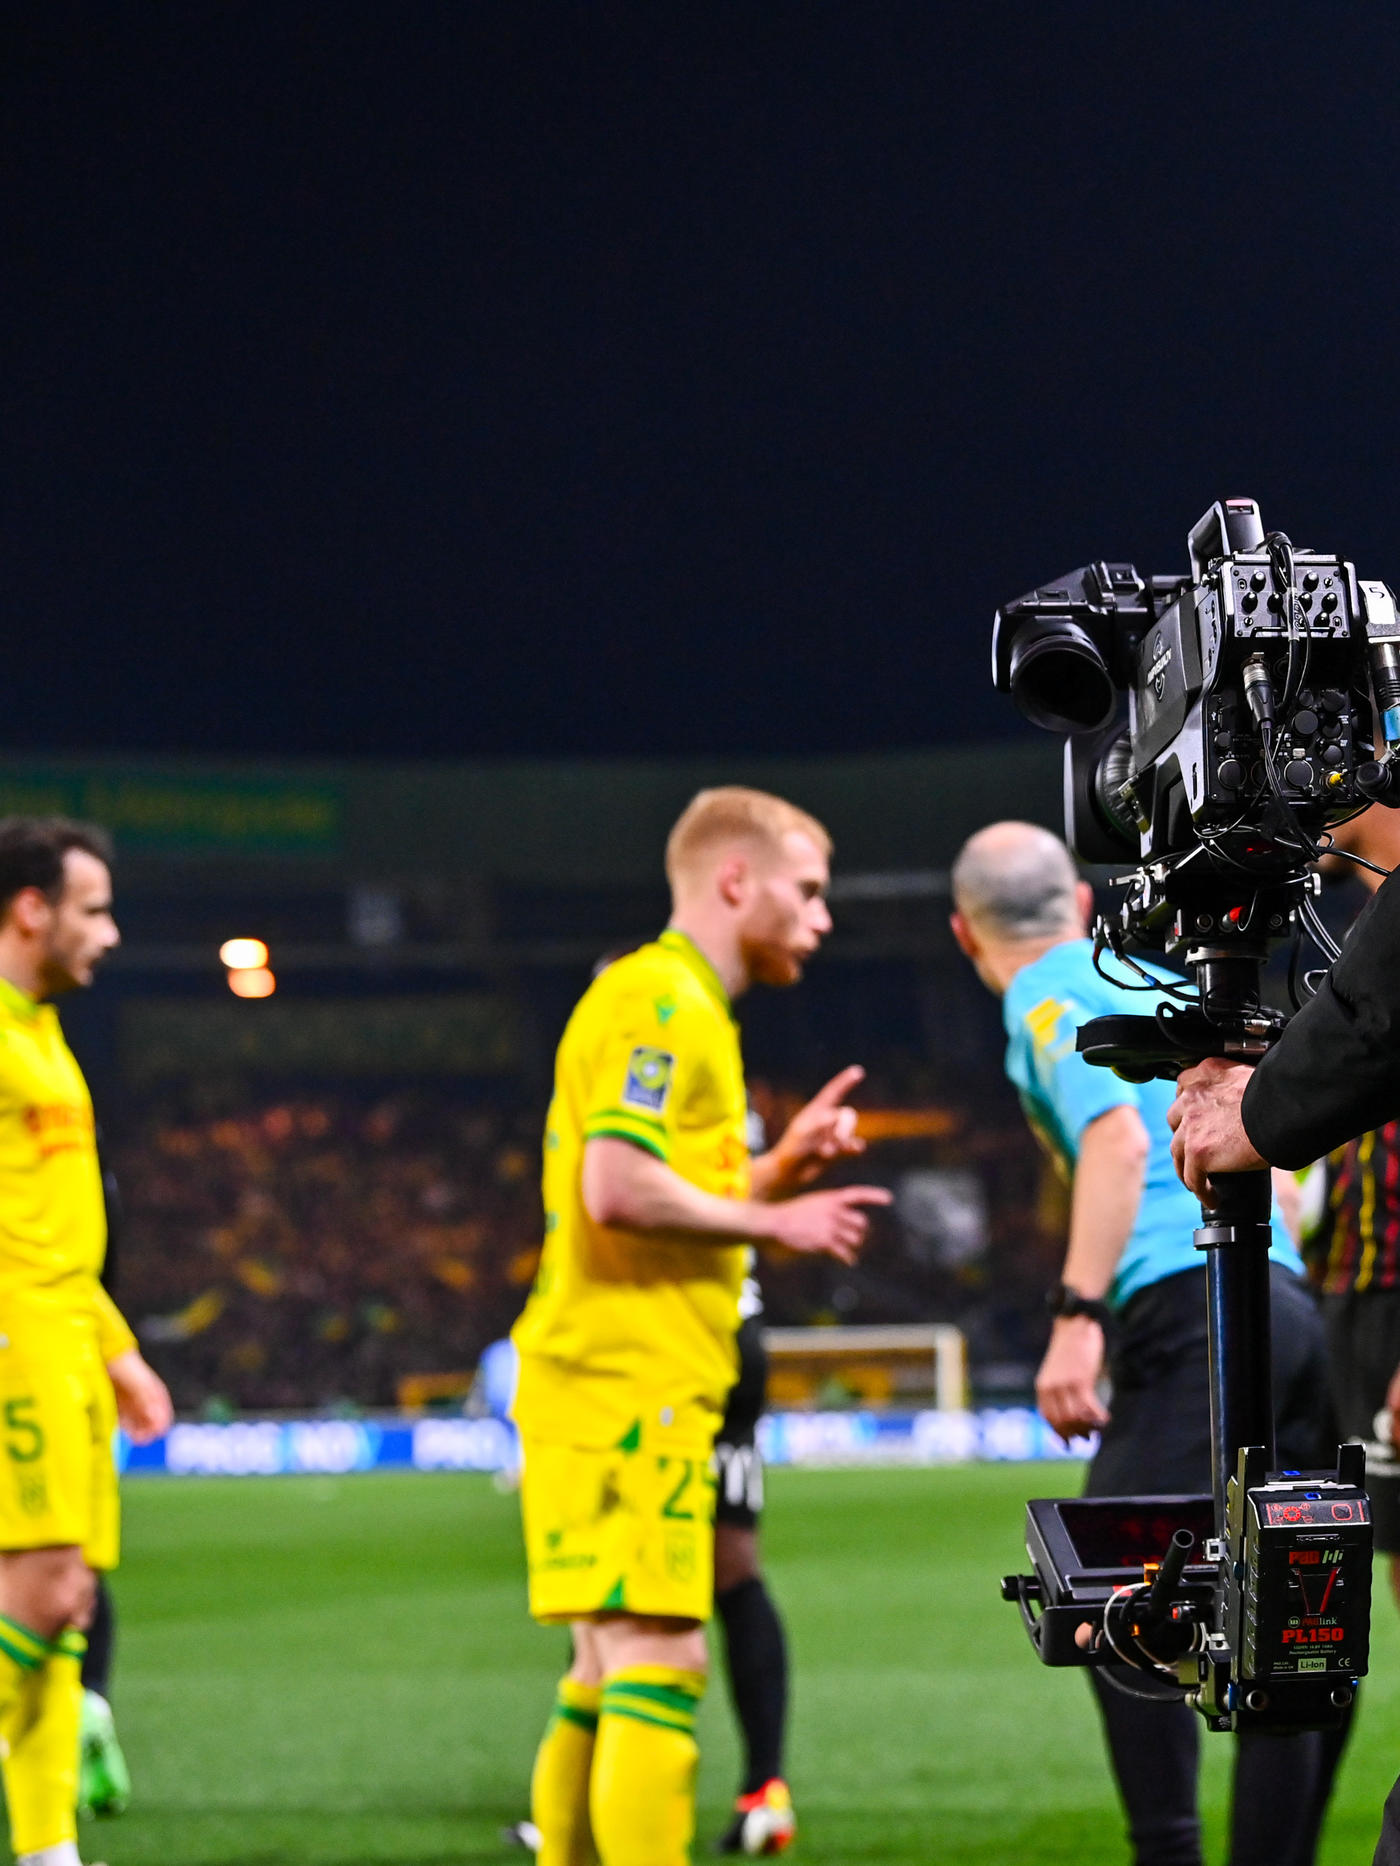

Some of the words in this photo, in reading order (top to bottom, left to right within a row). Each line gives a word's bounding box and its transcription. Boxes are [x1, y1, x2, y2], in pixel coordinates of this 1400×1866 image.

[1368, 586, 1385, 599] 5
[3, 1399, 46, 1463] 5
[1281, 1627, 1345, 1643] PL150
[1300, 1660, 1325, 1669] Li-Ion
